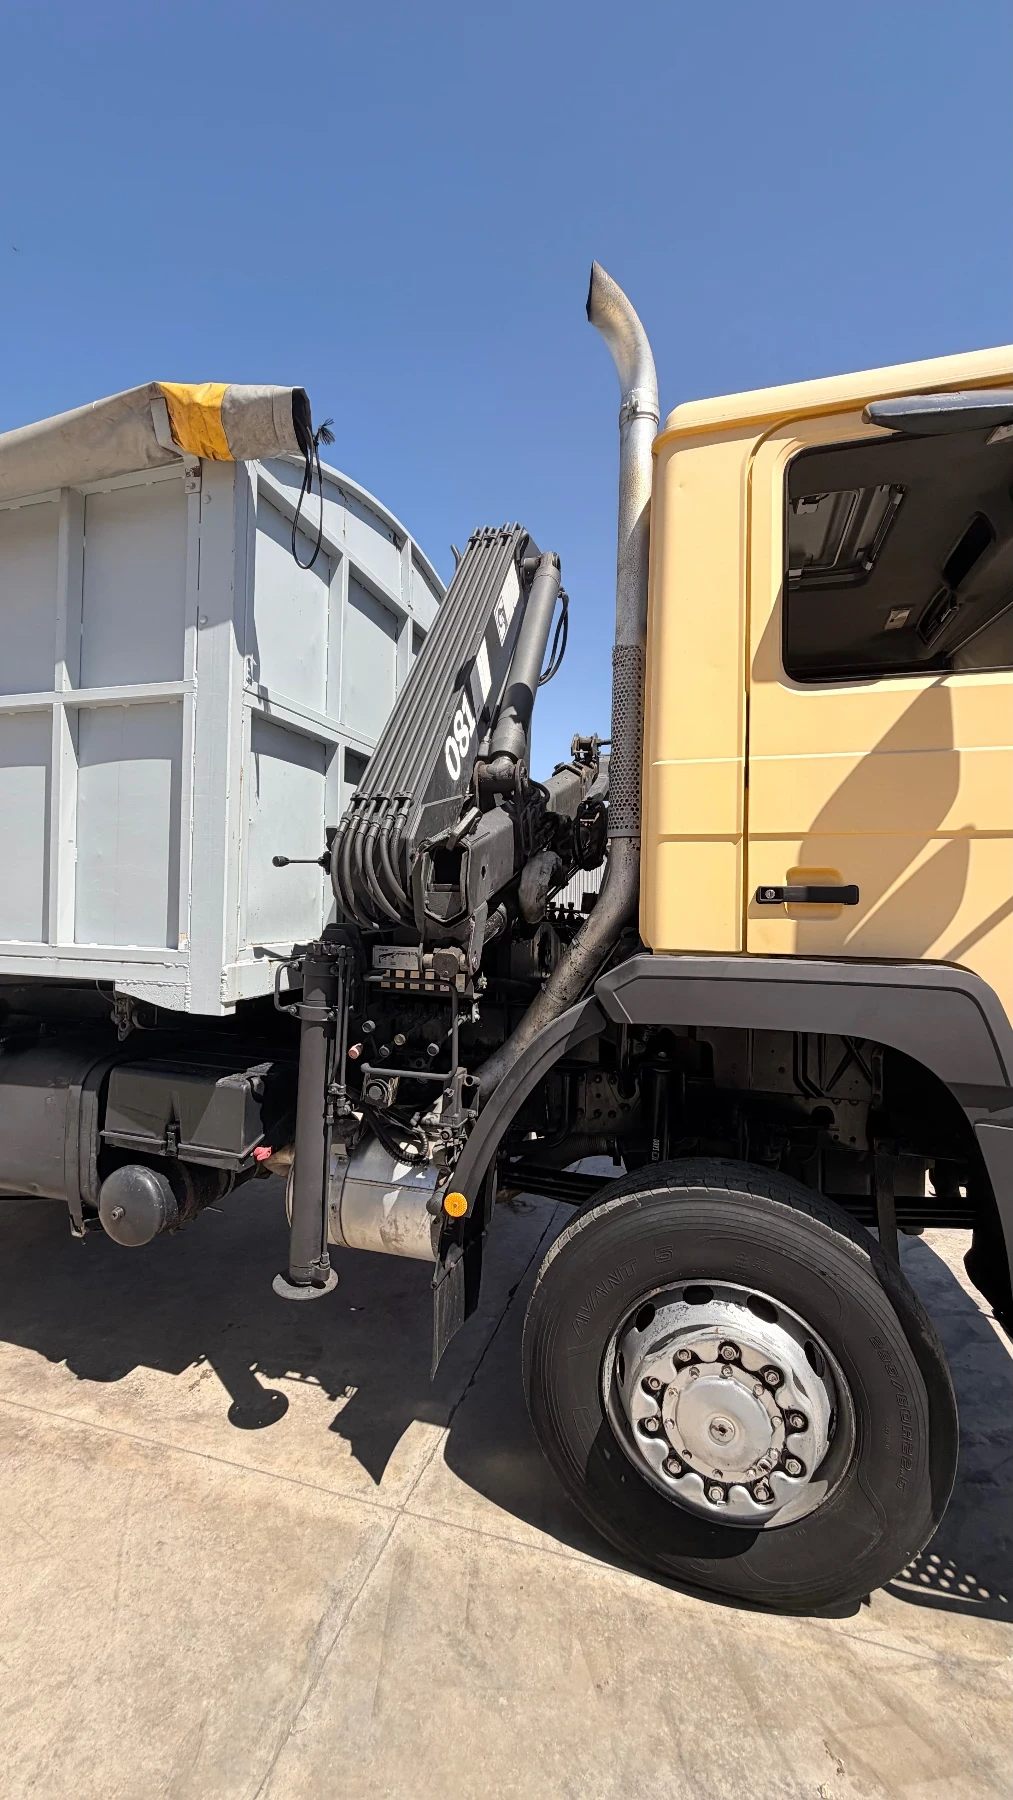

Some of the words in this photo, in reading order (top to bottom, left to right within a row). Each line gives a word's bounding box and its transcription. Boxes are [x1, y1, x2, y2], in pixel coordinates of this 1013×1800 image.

[444, 691, 477, 781] 081
[571, 1256, 638, 1340] AVANT
[653, 1244, 675, 1264] 5
